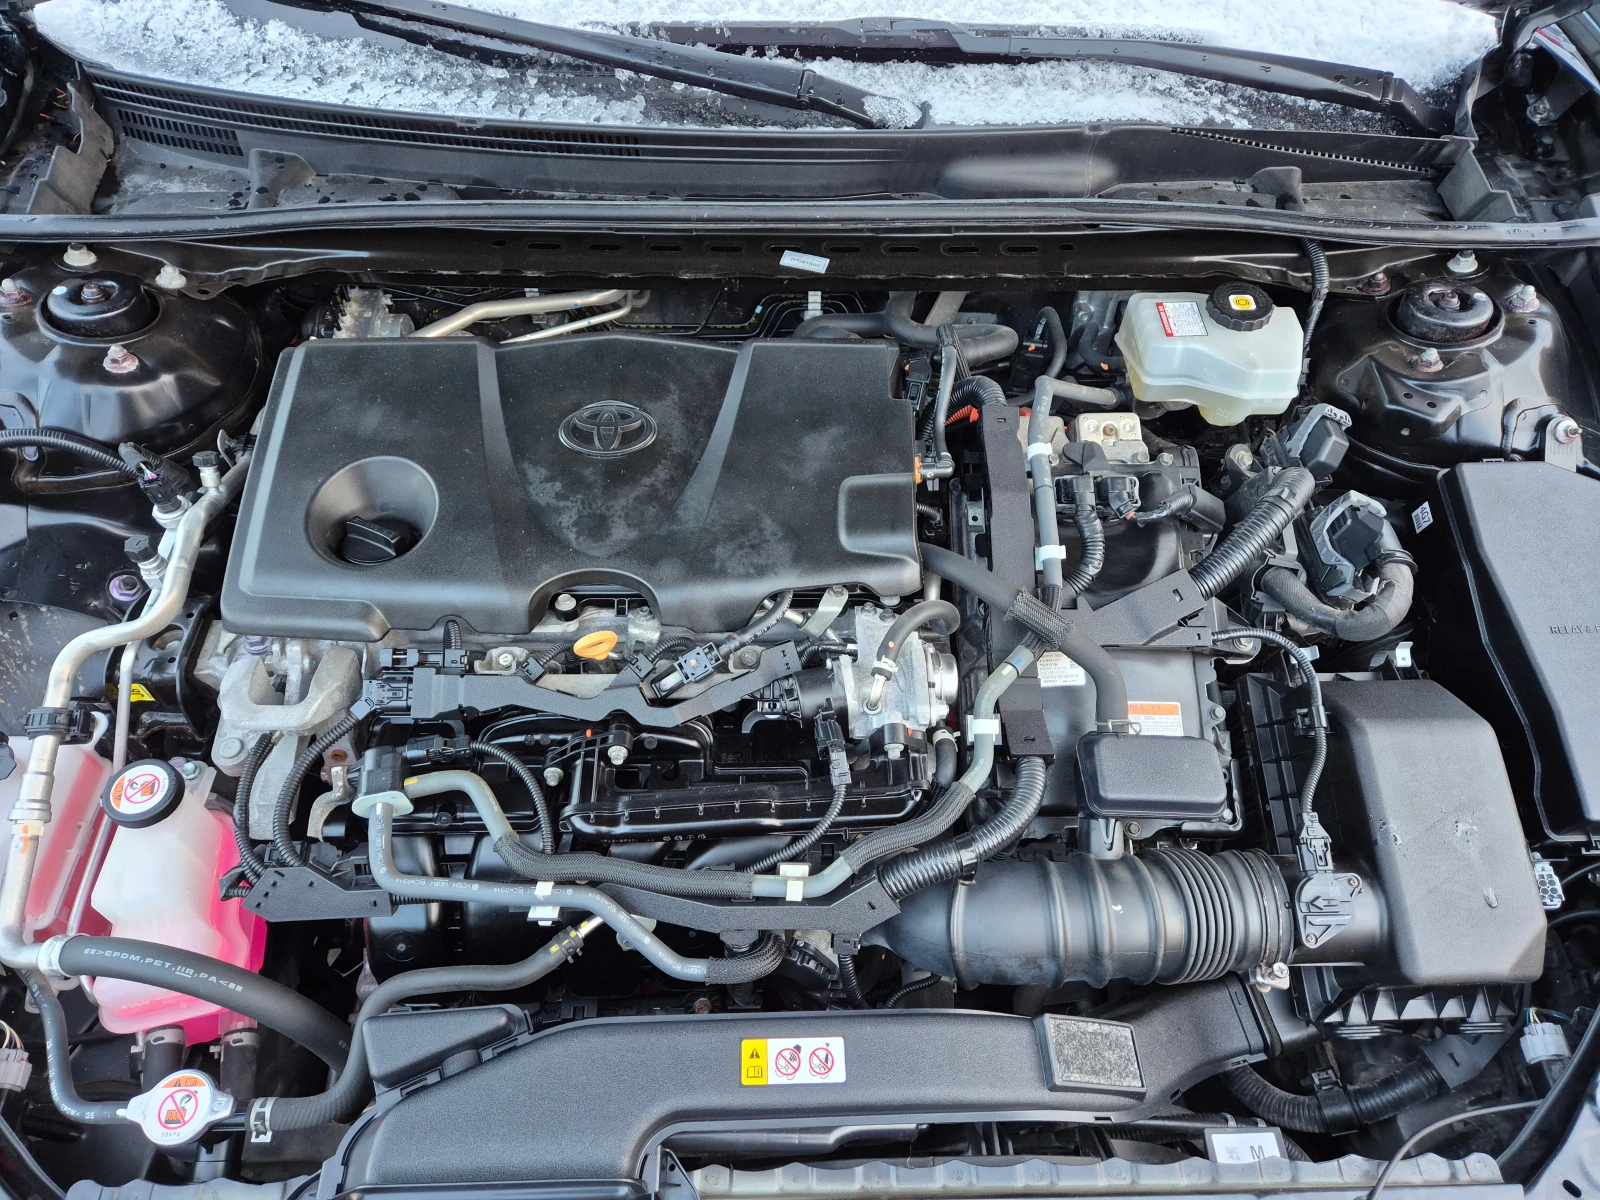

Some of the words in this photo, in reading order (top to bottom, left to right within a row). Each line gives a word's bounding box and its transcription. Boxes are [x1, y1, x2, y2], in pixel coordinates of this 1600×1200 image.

[1549, 624, 1583, 635] RELAY
[1585, 624, 1594, 634] &
[1249, 1145, 1267, 1160] M
